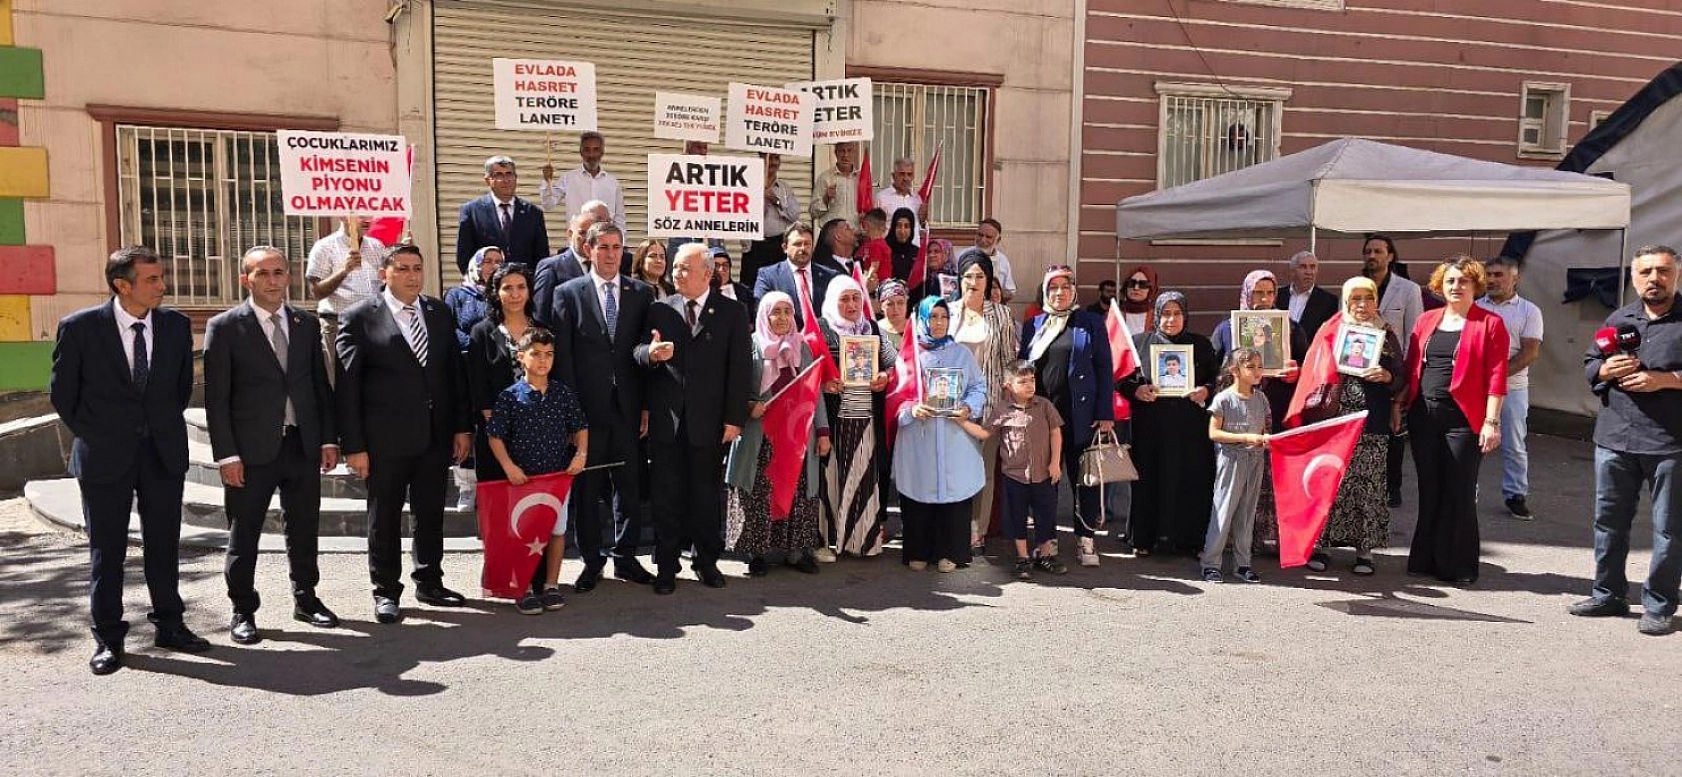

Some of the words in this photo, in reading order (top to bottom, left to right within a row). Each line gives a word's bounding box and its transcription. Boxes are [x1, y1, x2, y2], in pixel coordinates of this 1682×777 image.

[515, 64, 577, 77] EVLADA
[515, 80, 578, 93] HASRET
[801, 83, 859, 100] RTIK
[515, 95, 579, 109] TERÖRE
[746, 88, 800, 105] EVLADA
[519, 112, 576, 126] LANET!
[745, 104, 800, 120] HASRET
[813, 105, 862, 123] ETER
[743, 119, 799, 136] TERÖRE
[287, 136, 399, 152] ÇOCUKLARIMIZ
[746, 135, 795, 150] LANET!
[300, 154, 390, 174] KİMSENİN
[312, 173, 382, 192] PİYONU
[665, 161, 748, 187] ARTIK
[291, 195, 405, 211] OLMAYACAK
[665, 189, 750, 214] YETER
[654, 215, 681, 230] SÖZ
[684, 219, 759, 233] ANNELERİN
